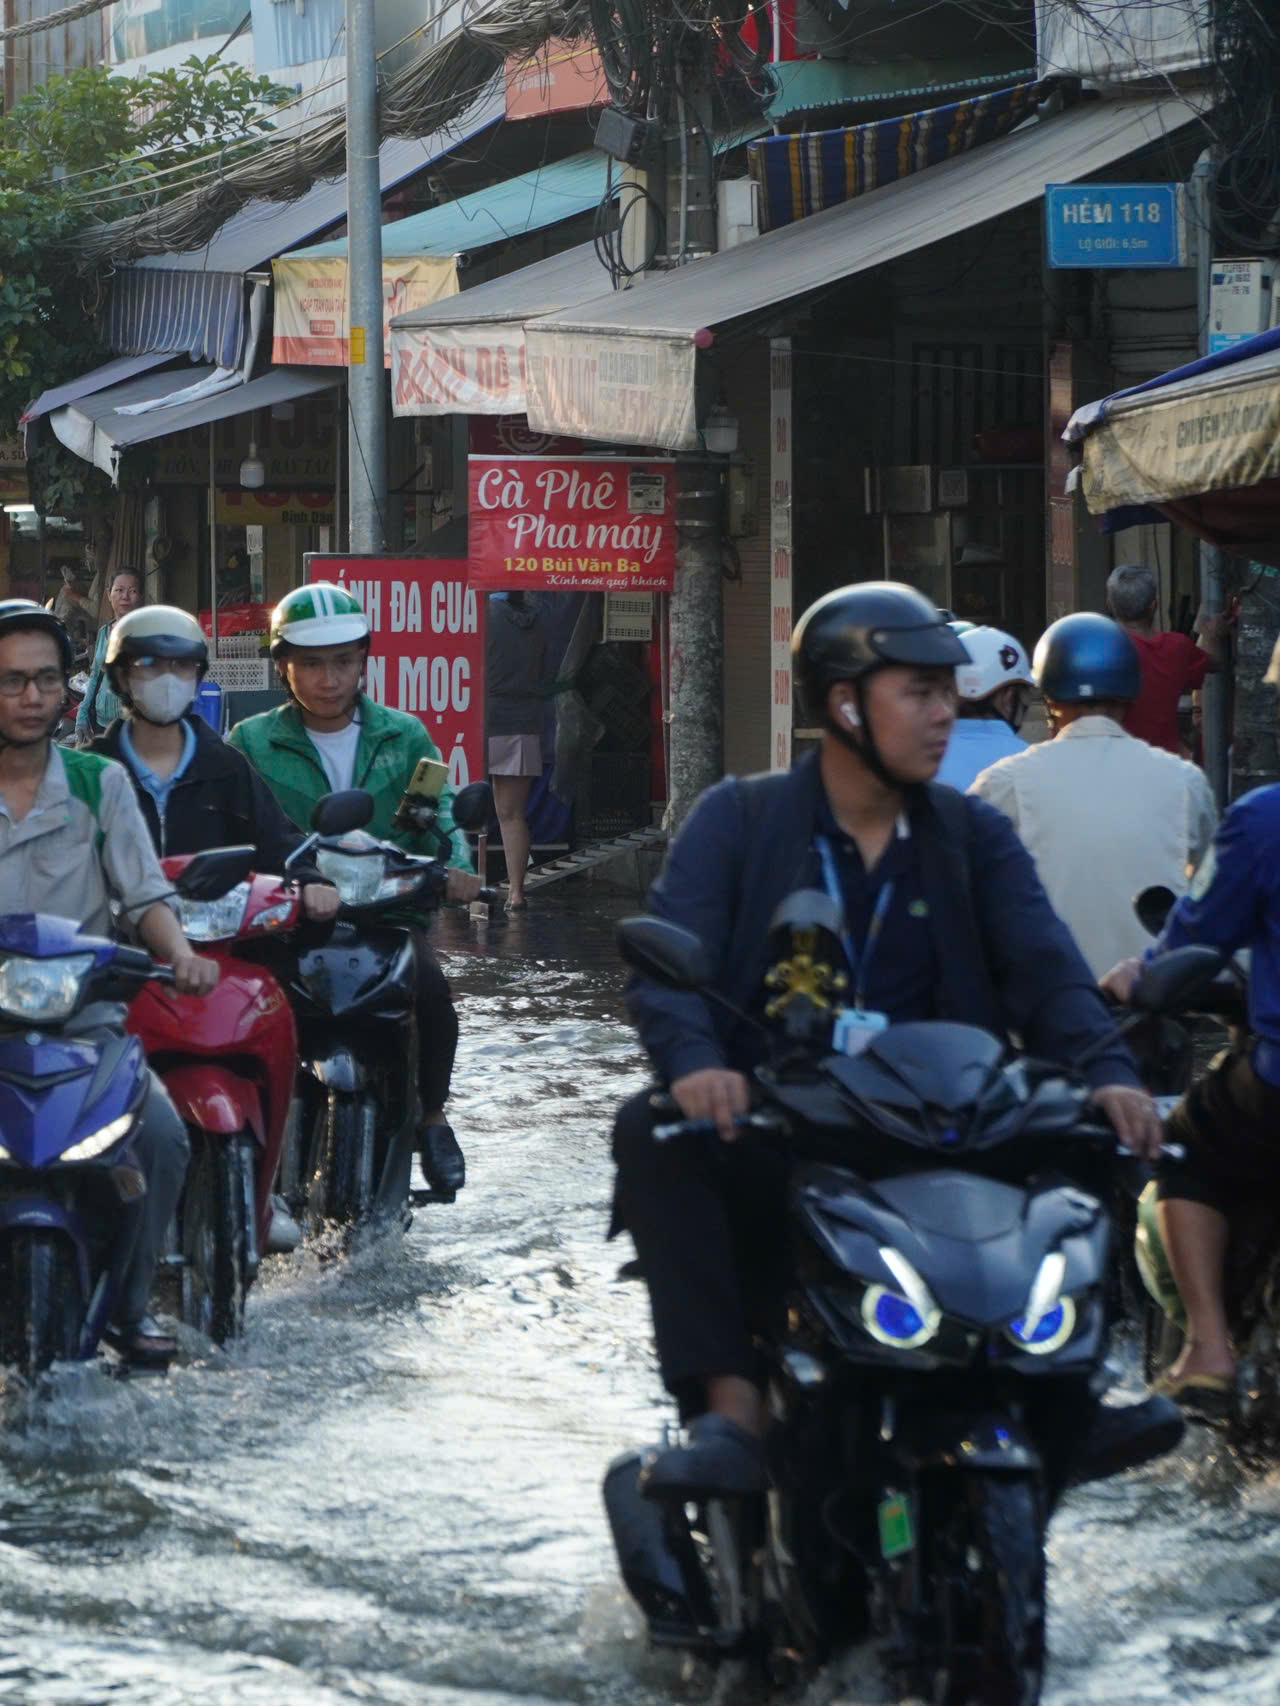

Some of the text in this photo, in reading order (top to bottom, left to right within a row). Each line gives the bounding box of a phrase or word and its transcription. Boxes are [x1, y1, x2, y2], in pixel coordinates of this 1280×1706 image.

[1120, 202, 1160, 224] 118
[478, 469, 616, 510] Cà Phê
[507, 513, 662, 563] Pha máy
[504, 556, 640, 573] 120 Bùi Văn Ba
[390, 581, 422, 633] ĐA
[431, 581, 477, 633] CUA
[399, 656, 470, 724] MỌC
